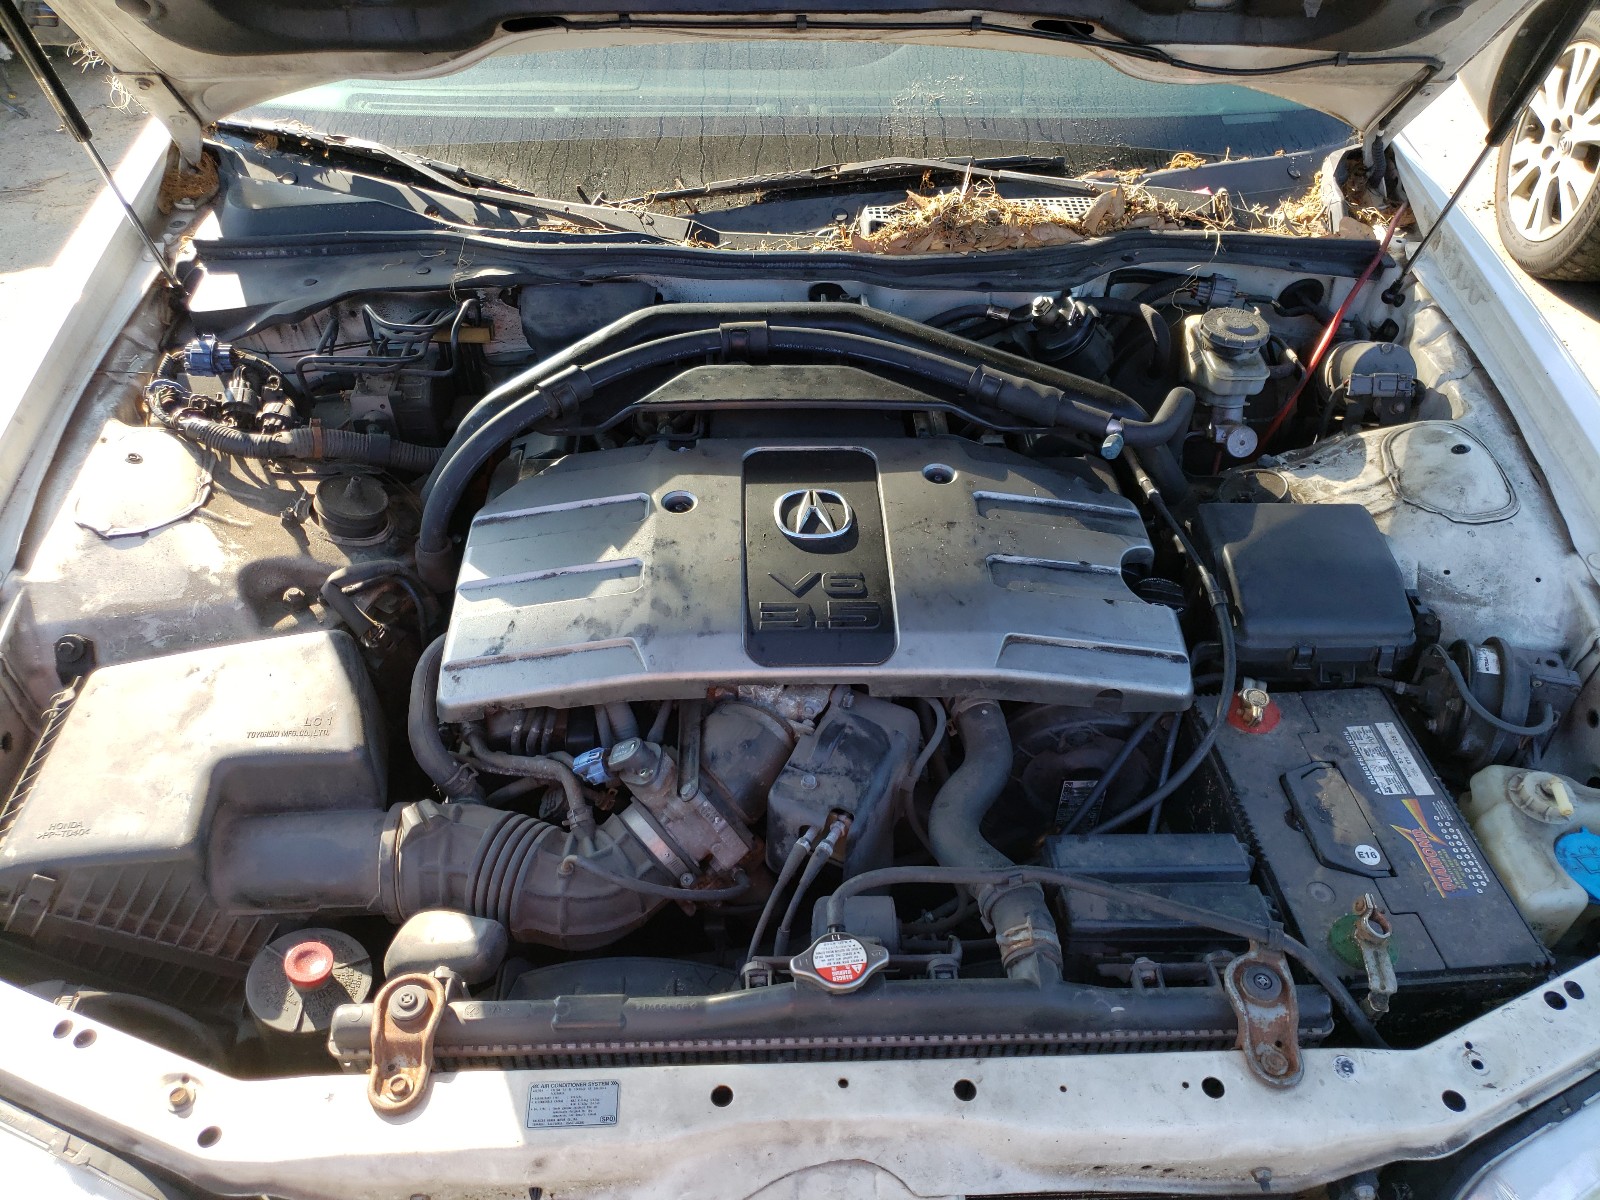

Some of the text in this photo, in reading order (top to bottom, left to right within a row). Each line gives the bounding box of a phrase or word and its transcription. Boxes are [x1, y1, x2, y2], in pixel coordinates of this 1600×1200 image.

[768, 571, 868, 599] V6
[758, 600, 882, 631] 3.5
[48, 820, 83, 831] HONDA
[551, 1081, 587, 1089] CONDITIONER
[587, 1080, 611, 1088] SYSTEM
